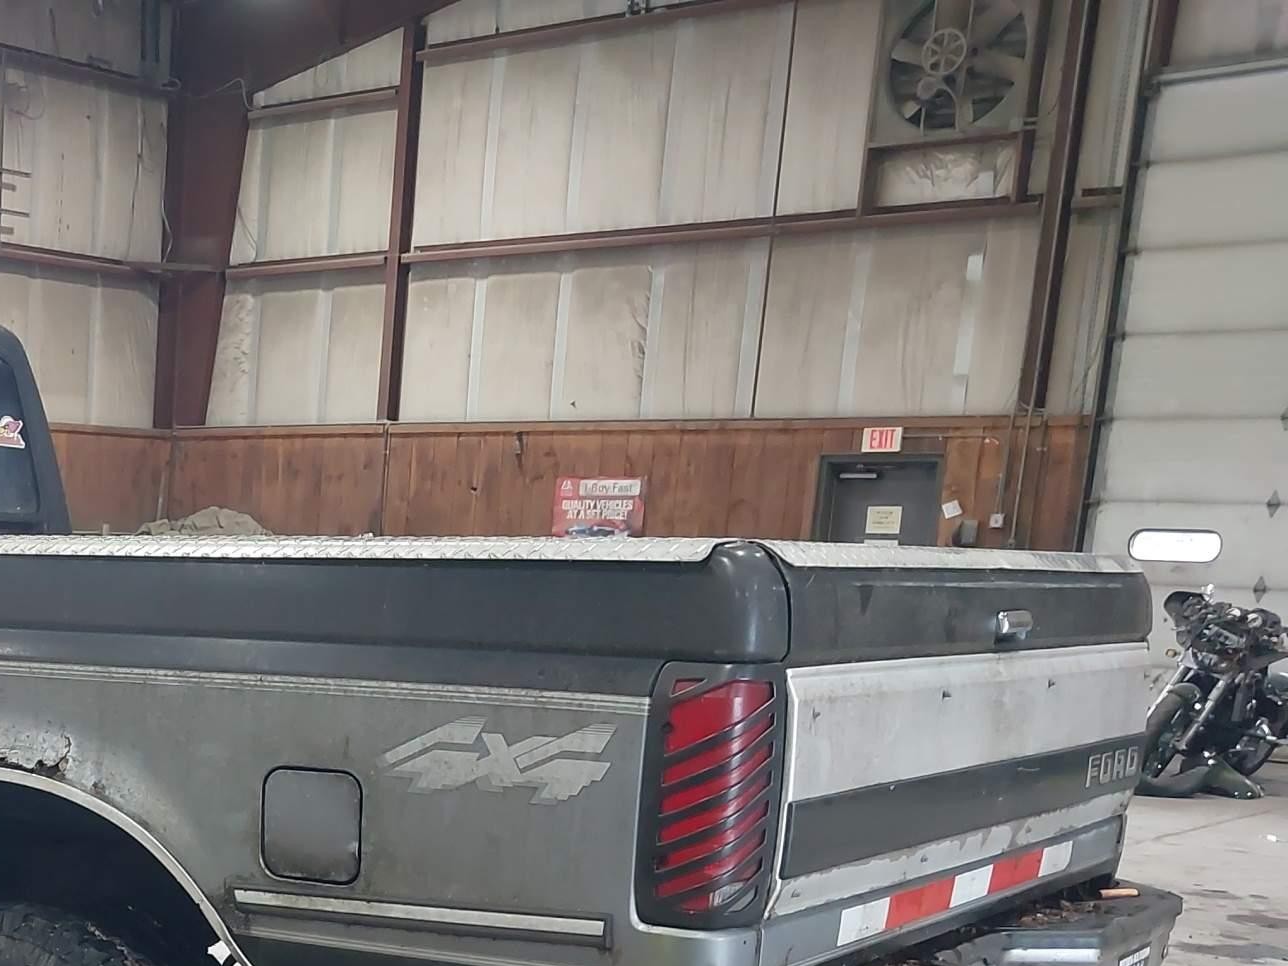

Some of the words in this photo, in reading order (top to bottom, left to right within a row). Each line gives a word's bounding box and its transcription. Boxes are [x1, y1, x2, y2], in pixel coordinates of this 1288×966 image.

[869, 429, 897, 449] EXIT
[612, 482, 633, 493] Fast
[561, 500, 595, 510] QUALITY
[596, 500, 633, 511] VEHICLES
[566, 509, 578, 520] AT
[1085, 746, 1139, 788] FORD
